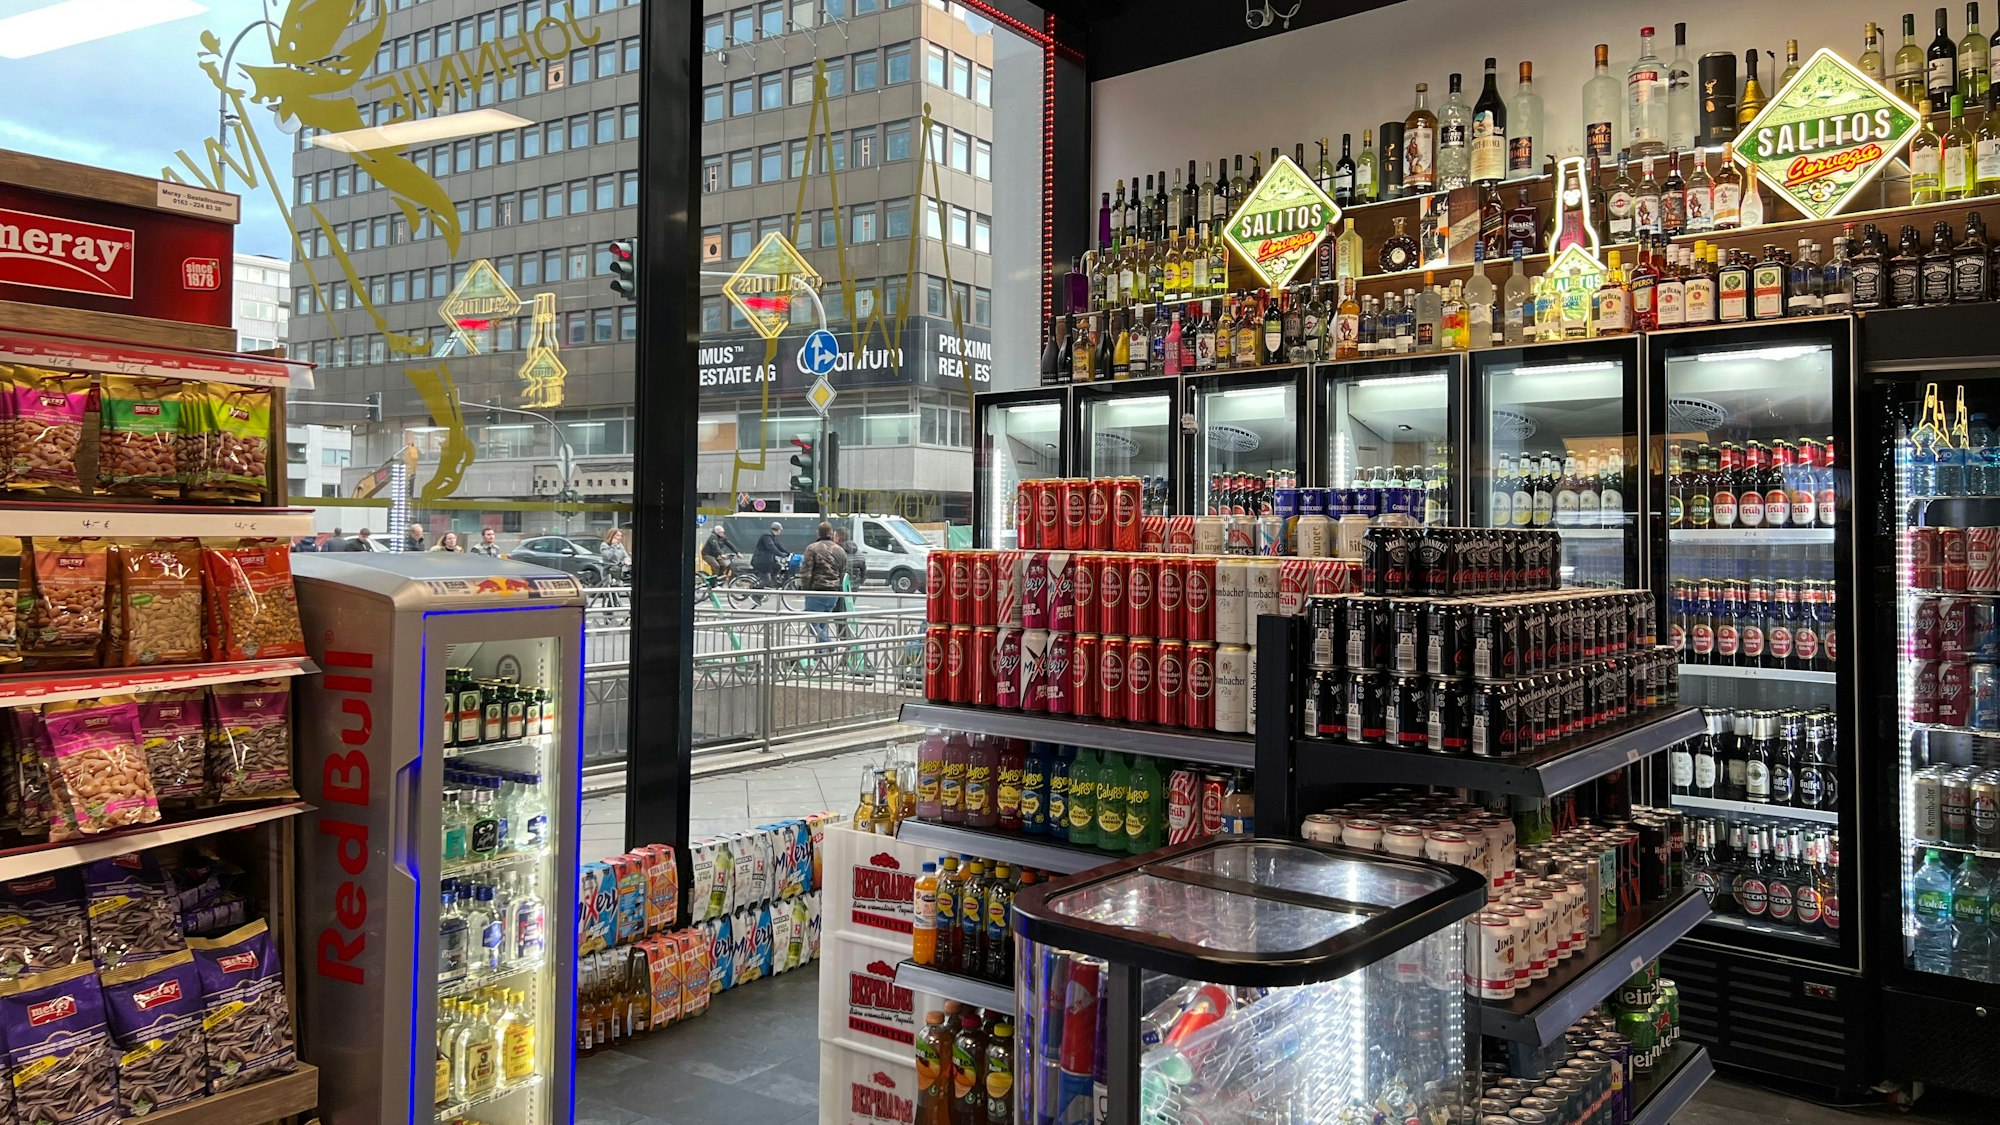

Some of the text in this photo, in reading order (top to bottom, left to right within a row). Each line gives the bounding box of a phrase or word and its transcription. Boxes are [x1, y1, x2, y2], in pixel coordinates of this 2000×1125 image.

[1593, 132, 1611, 143] MILE
[1757, 107, 1892, 157] SALITOS
[1515, 147, 1531, 158] MILE
[1785, 143, 1883, 181] Cerveza
[162, 189, 182, 198] Meray
[187, 193, 233, 207] Bestellnummer
[173, 198, 188, 206] 0163
[193, 201, 205, 209] 224
[205, 203, 214, 211] 83
[214, 204, 222, 212] 38
[1240, 202, 1323, 239] SALITOS
[1507, 221, 1534, 229] SEARS
[1257, 231, 1316, 256] Cerveza
[186, 262, 213, 273] since
[186, 273, 214, 287] 1978
[1696, 283, 1710, 293] BEAM
[1669, 286, 1682, 296] BEAM
[939, 356, 991, 382] REA ES
[700, 371, 751, 387] ESTATE
[1023, 608, 1041, 616] COLA
[1097, 783, 1127, 800] Calypso
[1927, 788, 1935, 827] Krombacher
[317, 650, 374, 985] Red Bull
[854, 911, 913, 933] IMPORTE
[1495, 935, 1509, 953] JIM
[851, 1018, 913, 1044] IMPORTED
